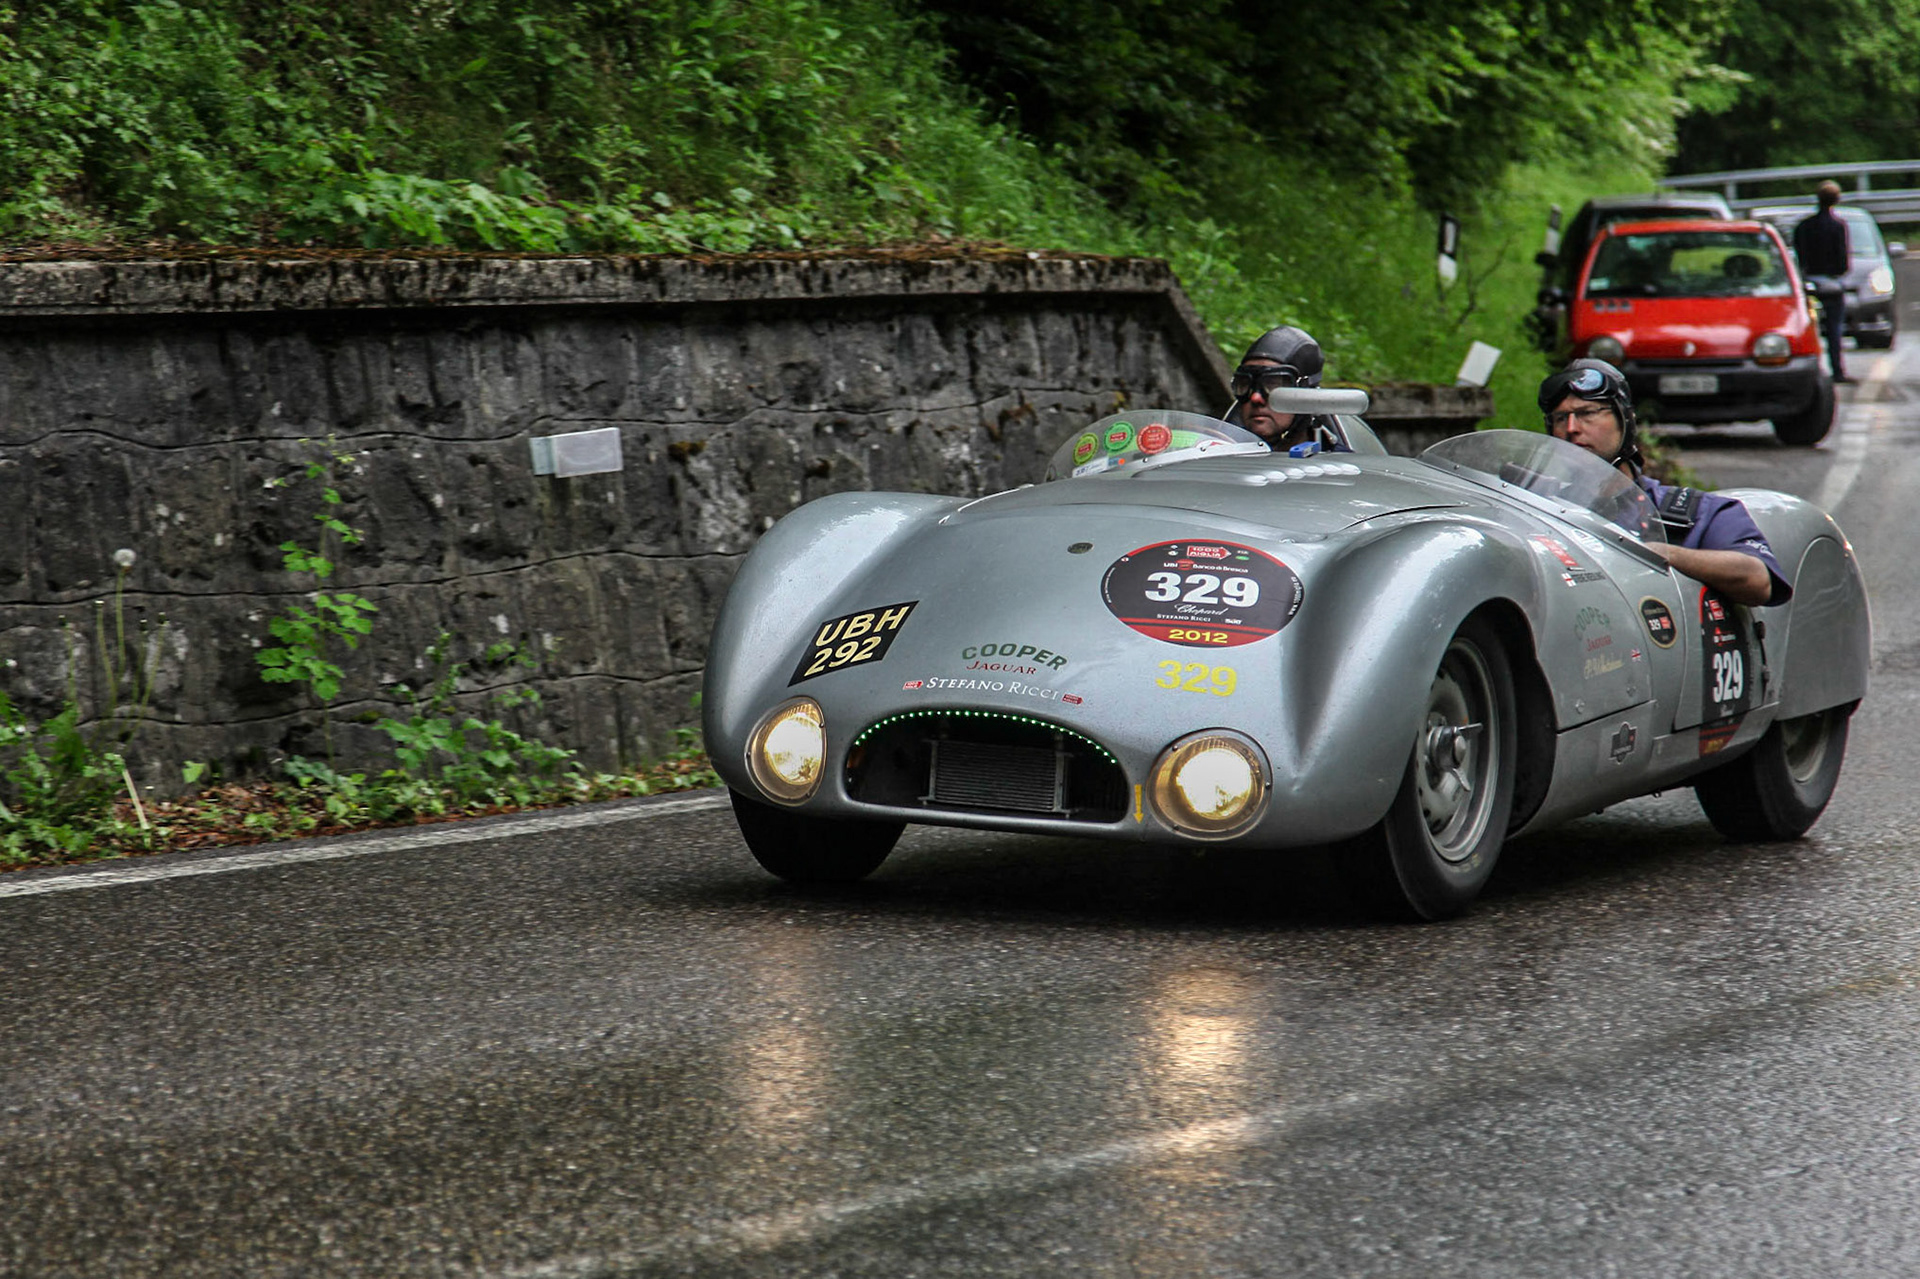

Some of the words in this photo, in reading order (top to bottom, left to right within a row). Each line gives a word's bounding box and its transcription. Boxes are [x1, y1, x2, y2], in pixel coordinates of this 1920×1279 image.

[1145, 571, 1260, 608] 329
[1156, 613, 1190, 621] STEFANO
[1174, 604, 1229, 616] Chopard
[815, 605, 910, 647] UBH
[1168, 628, 1229, 644] 2012
[1648, 618, 1662, 631] 329
[803, 635, 882, 677] 292
[961, 643, 1068, 671] COOPER
[966, 660, 1038, 675] JAGUAR
[926, 677, 1004, 692] STEFANO
[1006, 681, 1059, 701] RICCI
[1155, 659, 1238, 698] 329
[1712, 649, 1744, 703] 329
